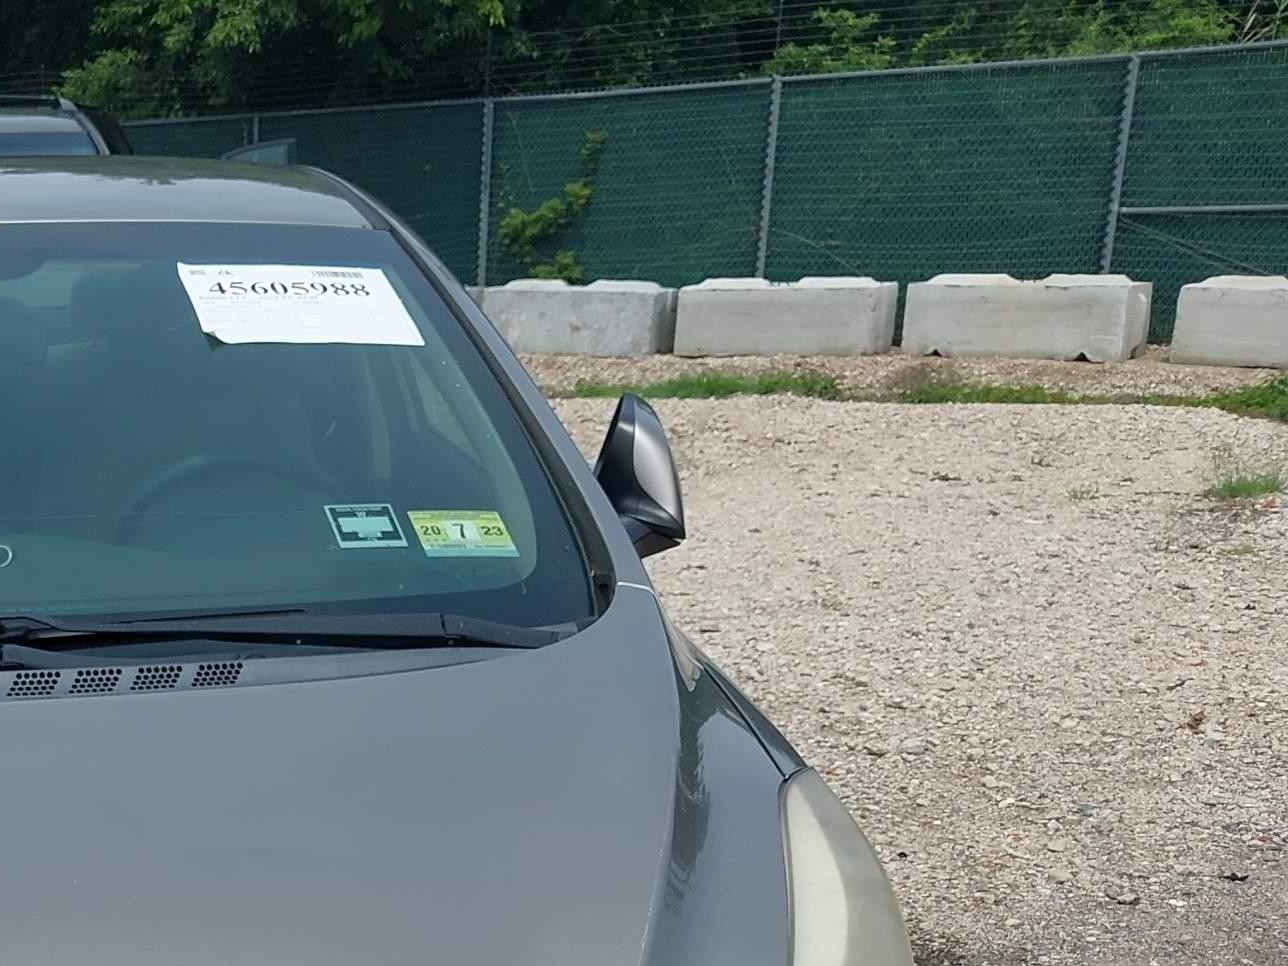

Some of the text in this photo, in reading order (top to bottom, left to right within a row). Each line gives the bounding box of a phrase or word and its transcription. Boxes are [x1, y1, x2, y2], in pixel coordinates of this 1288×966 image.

[209, 280, 371, 297] 45605988
[420, 523, 504, 539] 20 7 23
